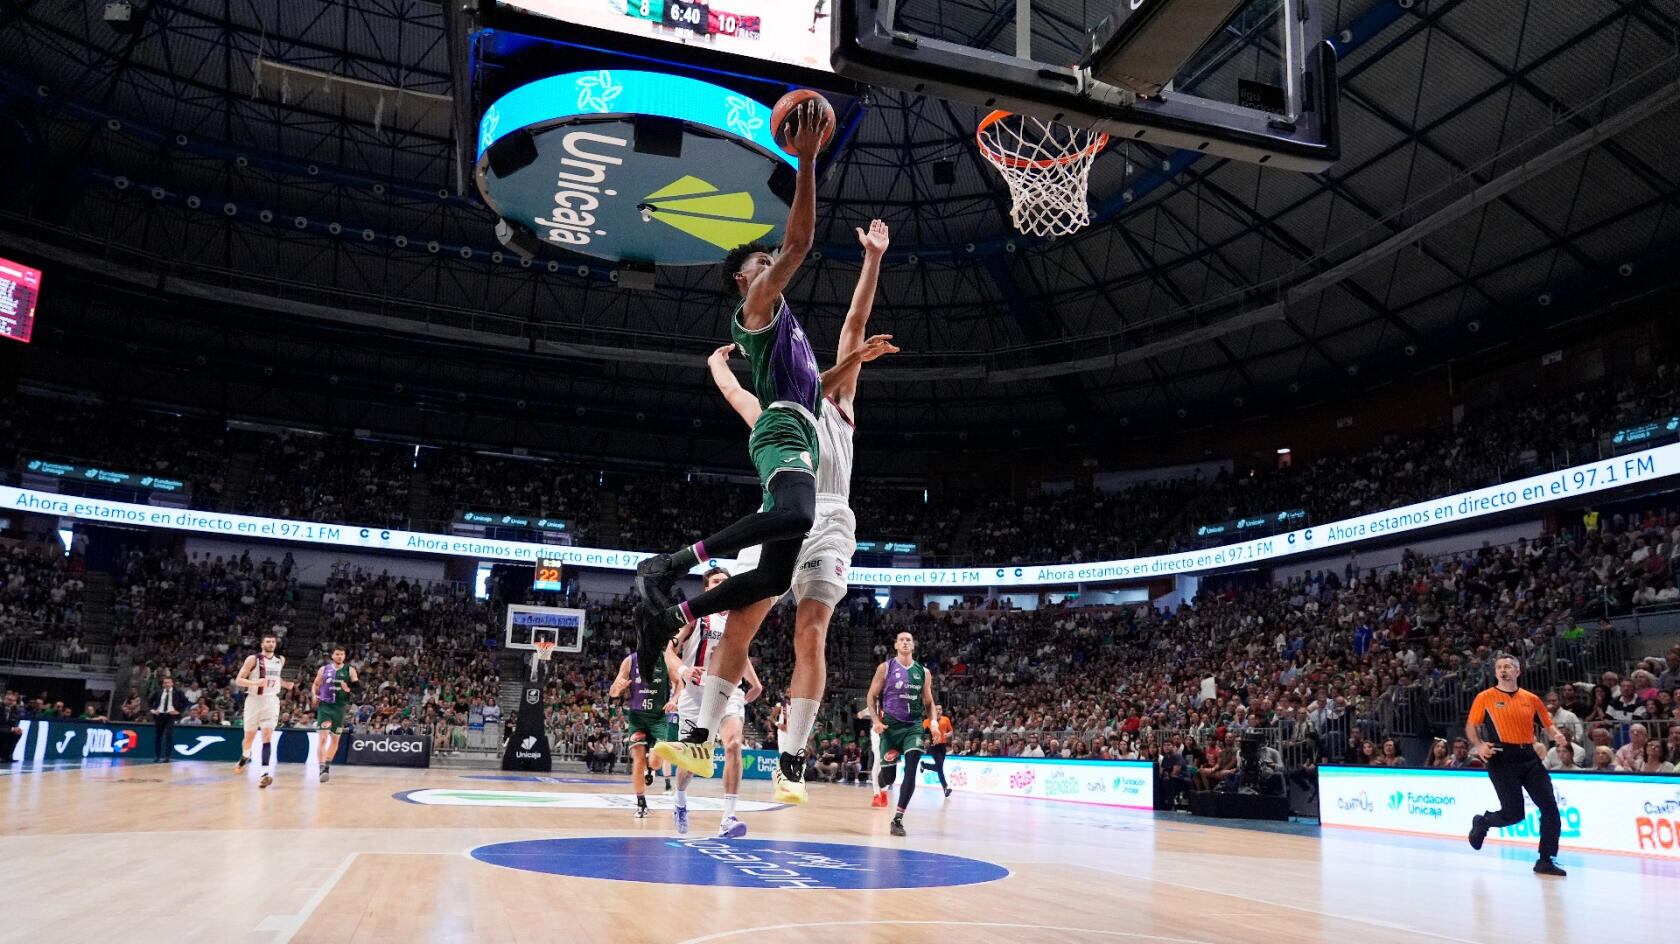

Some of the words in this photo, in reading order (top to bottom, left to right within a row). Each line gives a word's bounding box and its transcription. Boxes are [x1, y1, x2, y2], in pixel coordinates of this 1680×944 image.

[670, 3, 701, 24] 6:40
[718, 14, 736, 33] 10
[534, 131, 627, 245] Unicaja
[1328, 523, 1366, 542] Ahora
[1370, 510, 1430, 533] estamos
[1434, 504, 1453, 519] en
[1458, 490, 1517, 514] directo
[1522, 484, 1545, 500] en
[1550, 475, 1569, 495] el
[1573, 464, 1618, 490] 97.1
[1624, 455, 1655, 479] FM
[16, 493, 68, 512] Ahora
[74, 503, 145, 521] estamos
[151, 512, 171, 525] en
[176, 513, 233, 531] directo
[237, 521, 257, 533] en
[261, 522, 275, 535] el
[280, 523, 313, 539] 97.1
[319, 526, 340, 540] FM
[407, 535, 448, 551] Ahora
[453, 542, 510, 556] estamos
[514, 548, 531, 558] en
[535, 548, 582, 562] directo
[586, 553, 604, 564] en
[606, 553, 619, 565] el
[622, 555, 639, 566] 97
[847, 567, 892, 583] directo
[900, 571, 912, 583] en
[914, 568, 926, 583] el
[930, 570, 958, 583] 97.1
[962, 571, 980, 583] FM
[1037, 568, 1075, 581] Ahora
[1078, 563, 1130, 578] estamos
[1133, 562, 1149, 574] en
[1151, 557, 1194, 572] directo
[1197, 554, 1212, 566] en
[1214, 549, 1226, 564] el
[1228, 545, 1254, 562] 97.1
[1257, 541, 1274, 557] FM
[540, 569, 559, 582] 22
[641, 698, 654, 710] 45
[352, 738, 423, 753] endesa
[516, 751, 542, 760] Unicaja
[1407, 792, 1456, 806] Fundación
[1408, 804, 1442, 820] Unicaja
